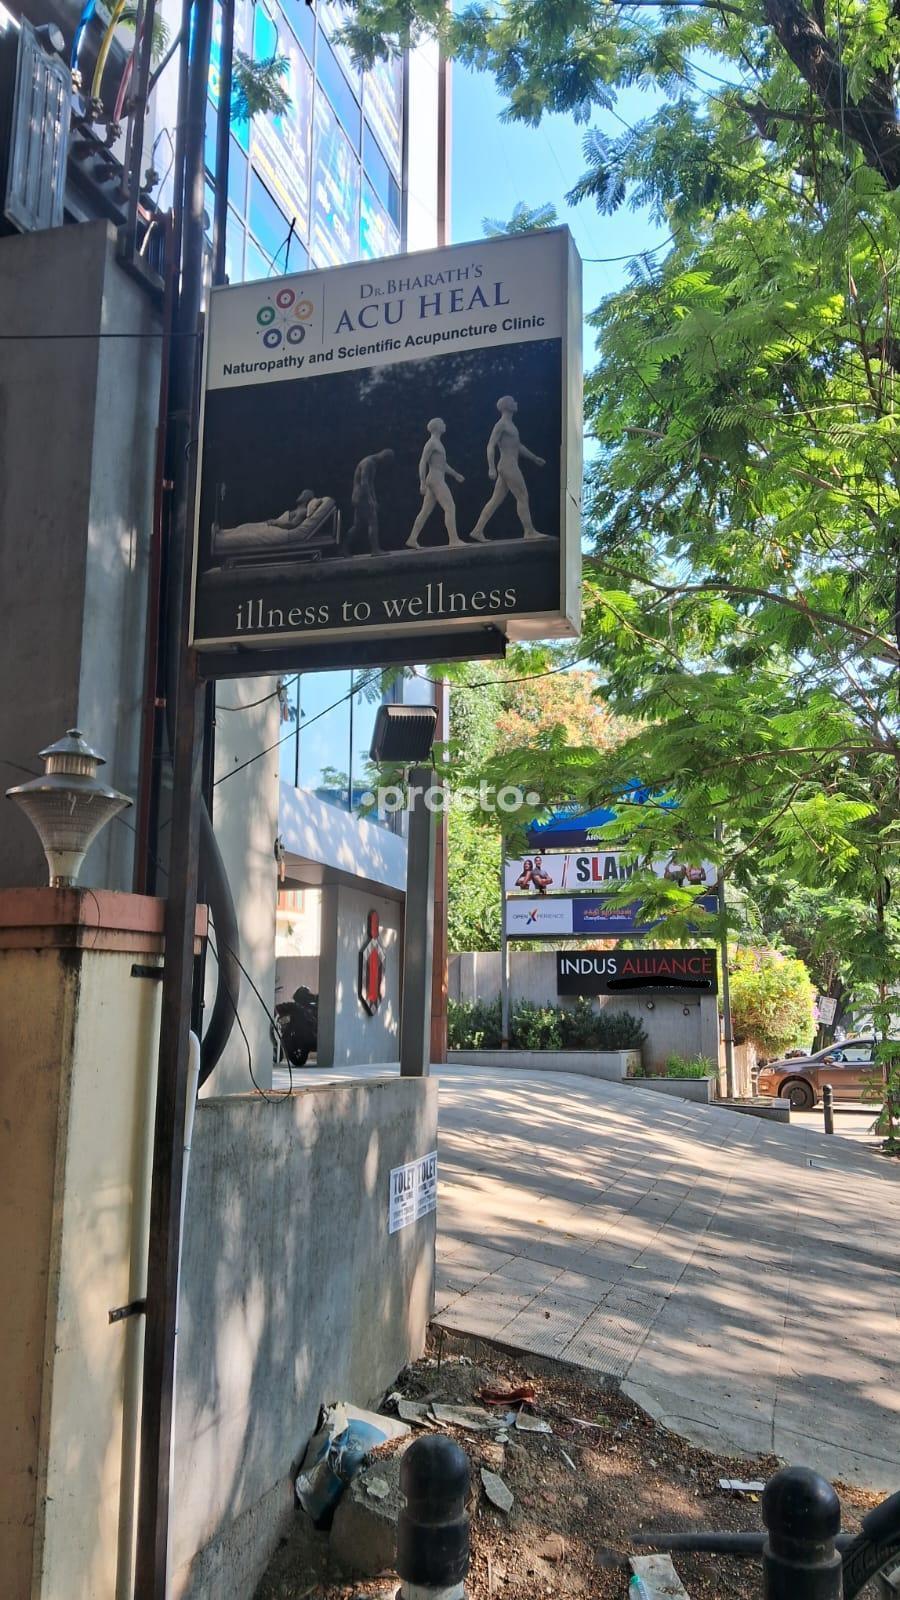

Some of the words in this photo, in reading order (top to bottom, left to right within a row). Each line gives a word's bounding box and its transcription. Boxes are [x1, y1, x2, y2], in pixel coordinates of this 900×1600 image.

[334, 299, 404, 334] ACU
[419, 282, 510, 319] HEAL
[223, 353, 305, 376] Naturopathy
[308, 349, 334, 364] and
[337, 338, 401, 360] Scientific
[404, 322, 498, 348] Acupuncture
[502, 315, 546, 331] Clinic
[235, 599, 329, 630] illness
[342, 600, 371, 622] to
[382, 582, 518, 618] wellness
[560, 958, 617, 975] INDUS
[621, 957, 712, 975] ALLIANCE
